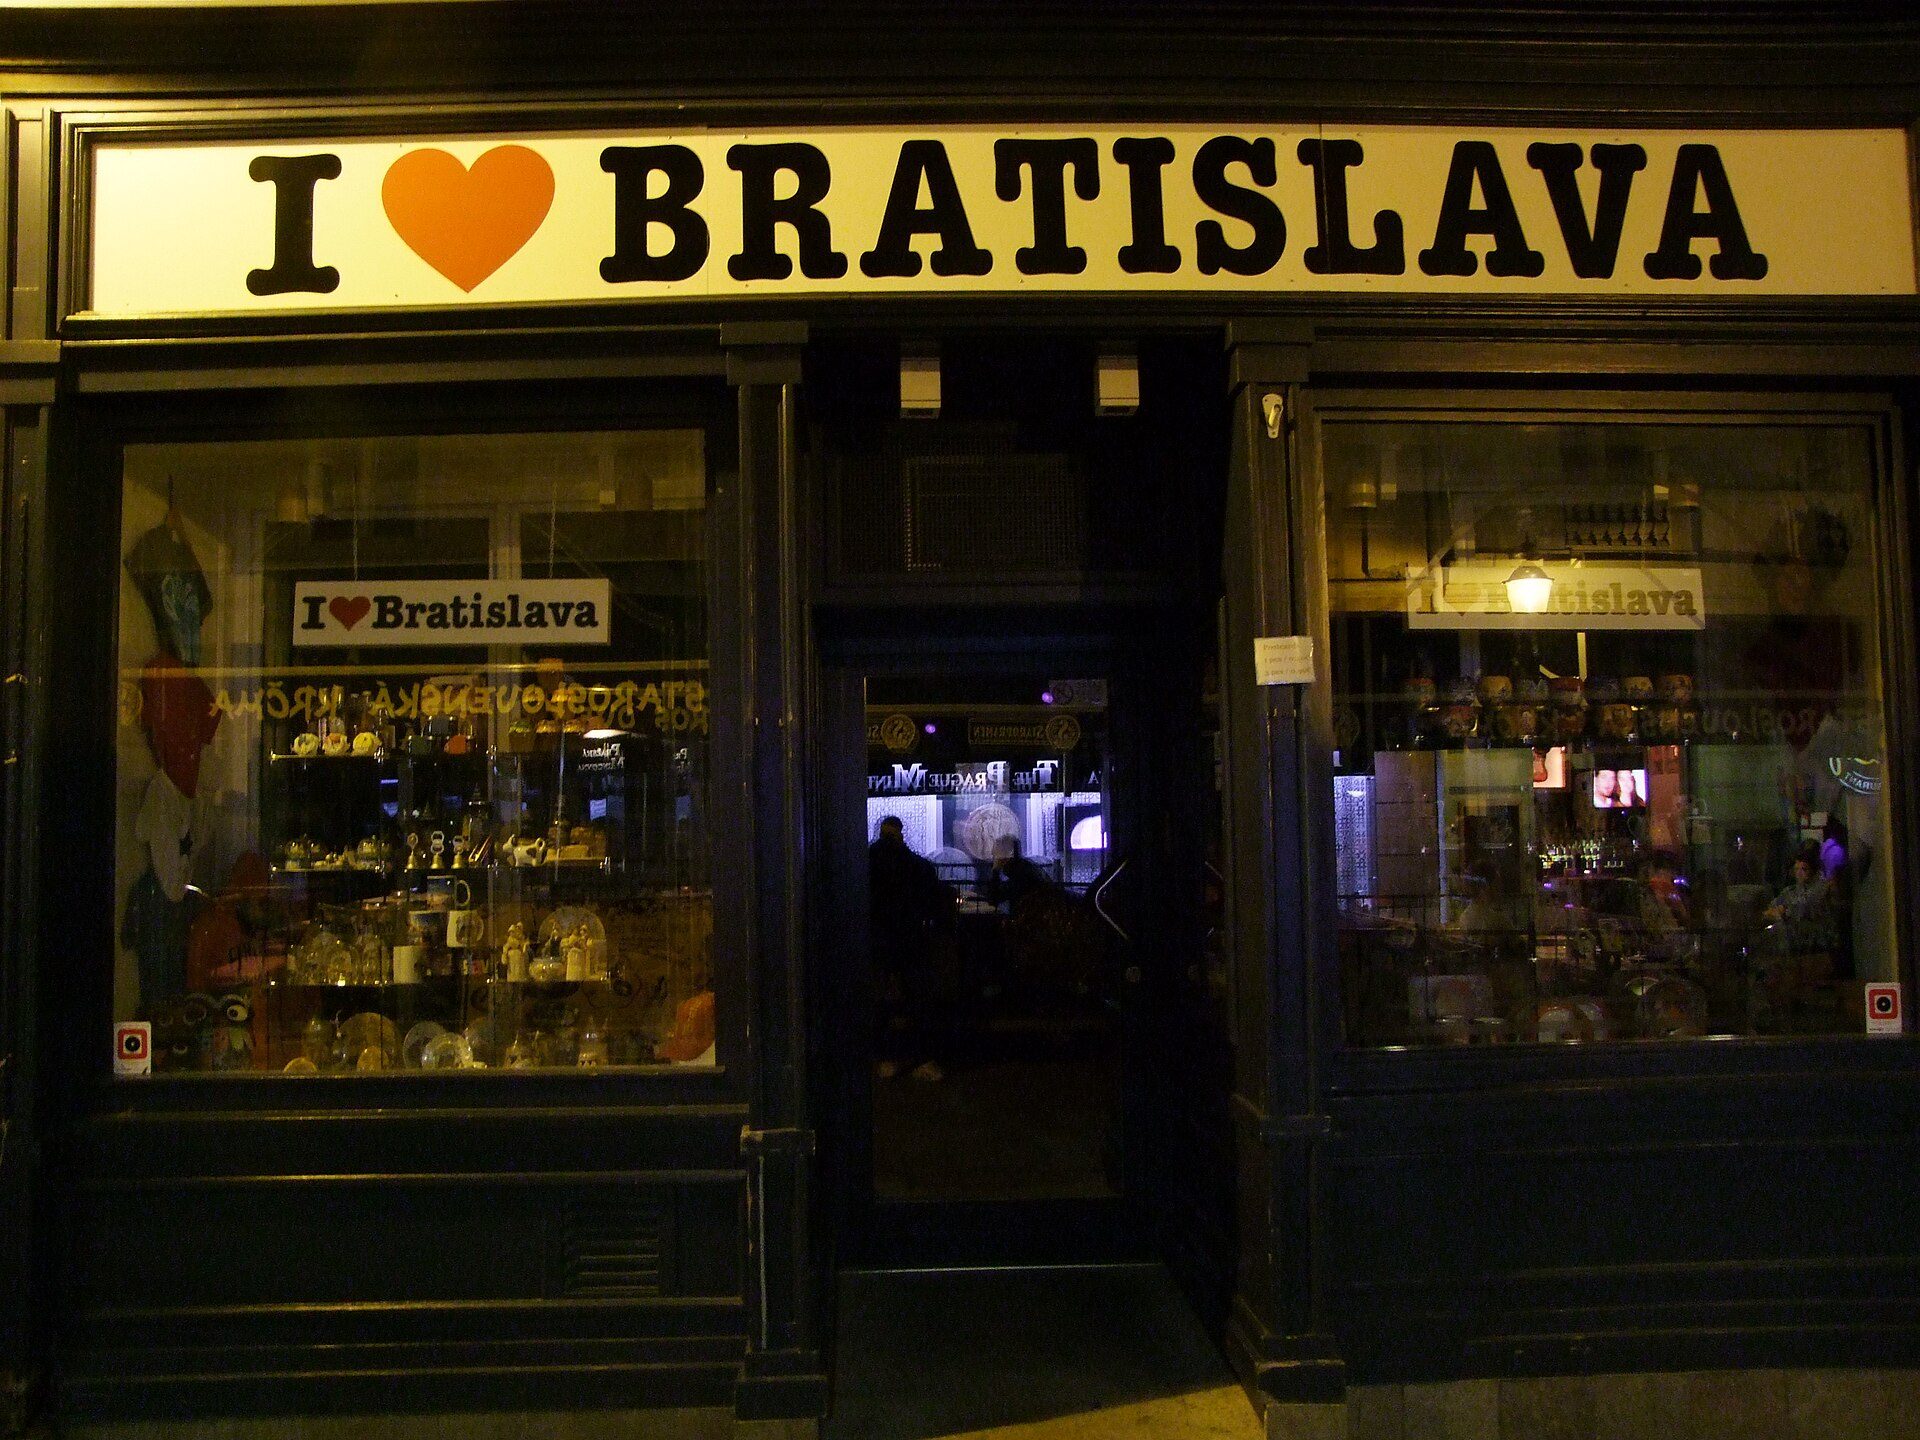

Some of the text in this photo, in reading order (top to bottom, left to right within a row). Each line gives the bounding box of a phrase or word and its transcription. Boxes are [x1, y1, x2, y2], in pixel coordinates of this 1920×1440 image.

[247, 136, 1768, 295] I BRATISLAVA
[301, 592, 599, 630] I Bratislava
[1484, 580, 1697, 616] Batislava
